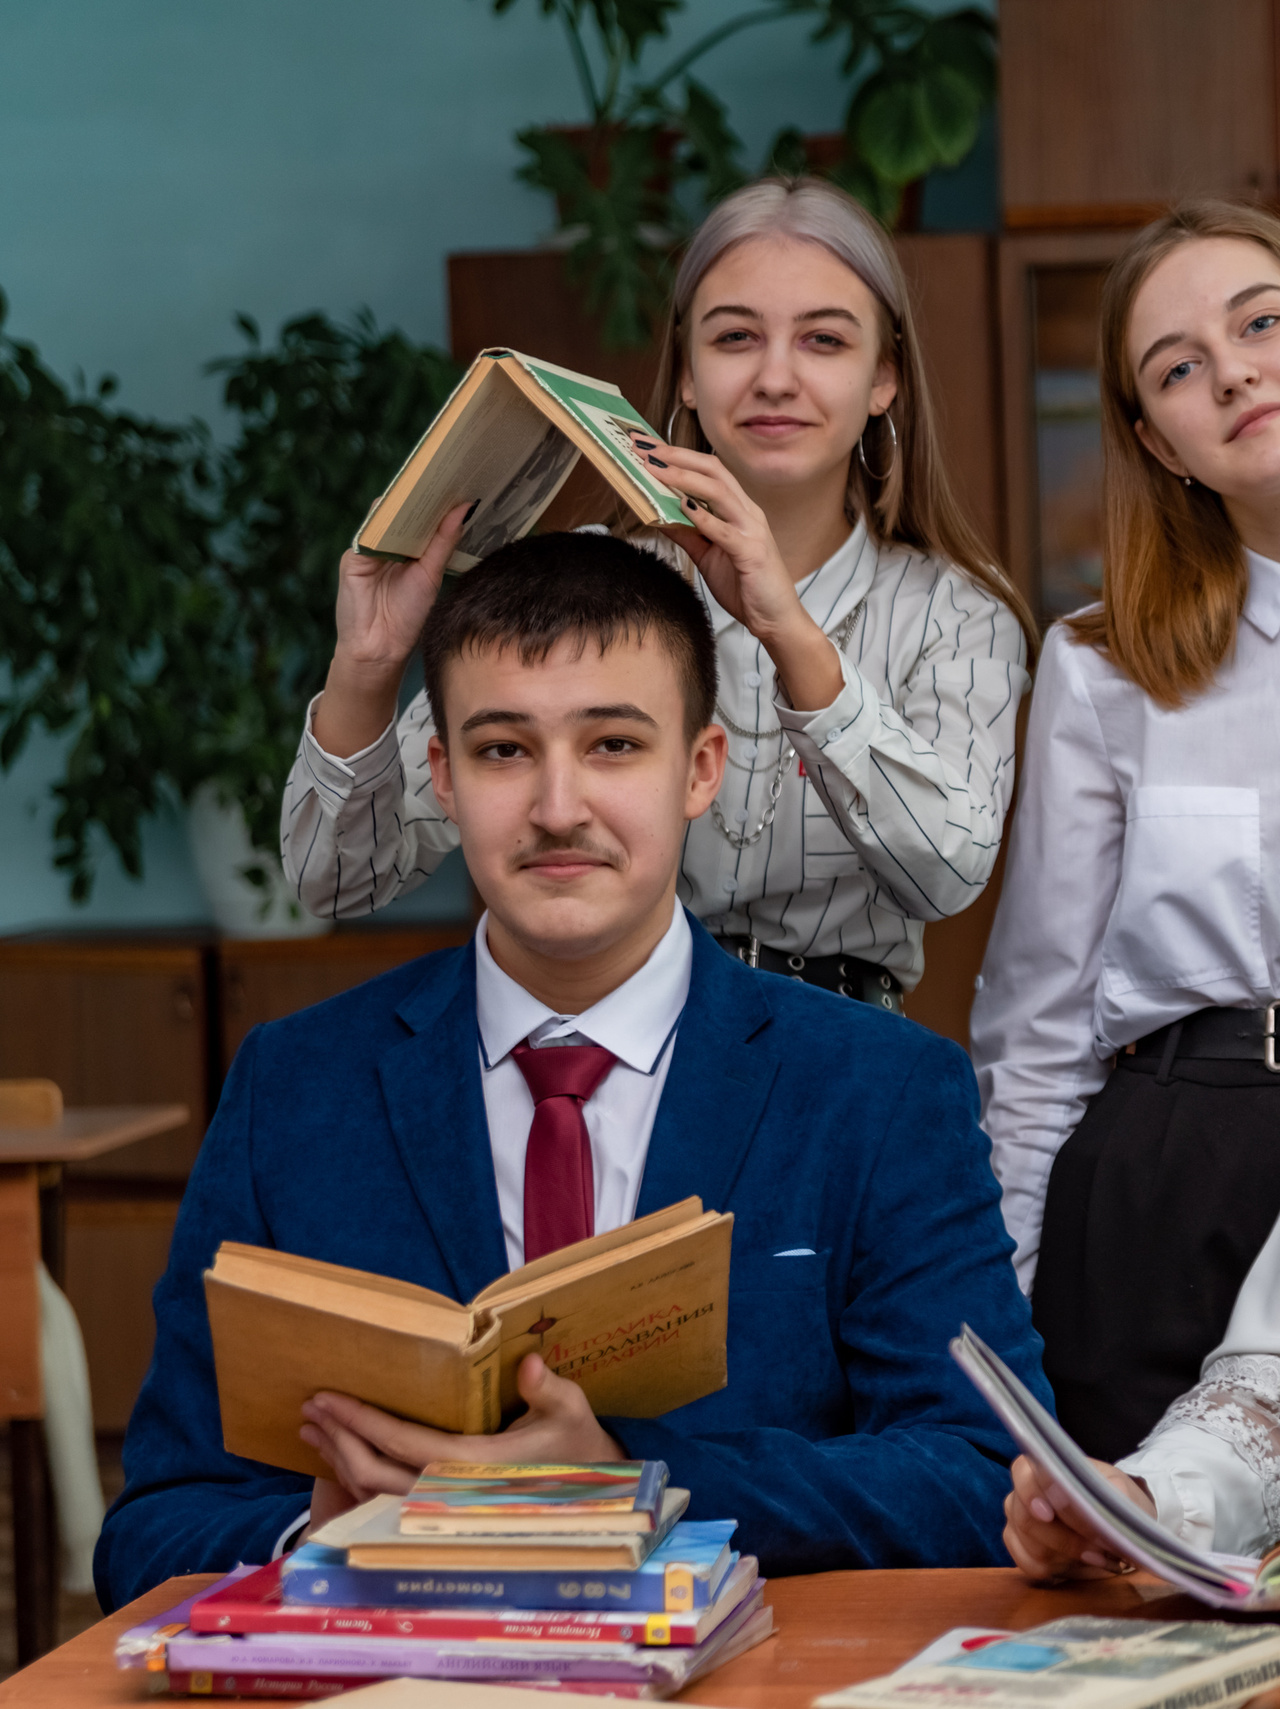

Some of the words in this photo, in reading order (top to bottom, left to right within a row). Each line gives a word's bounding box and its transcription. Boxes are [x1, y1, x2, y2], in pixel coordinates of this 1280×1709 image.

[397, 1580, 504, 1597] Геометрия
[334, 1619, 372, 1632] Часть
[504, 1624, 543, 1637] России
[547, 1624, 602, 1639] История
[437, 1656, 530, 1671] АНГЛИЙСКИЙ
[533, 1658, 572, 1673] ЯЗЫК
[253, 1677, 304, 1692] История
[306, 1679, 344, 1692] России
